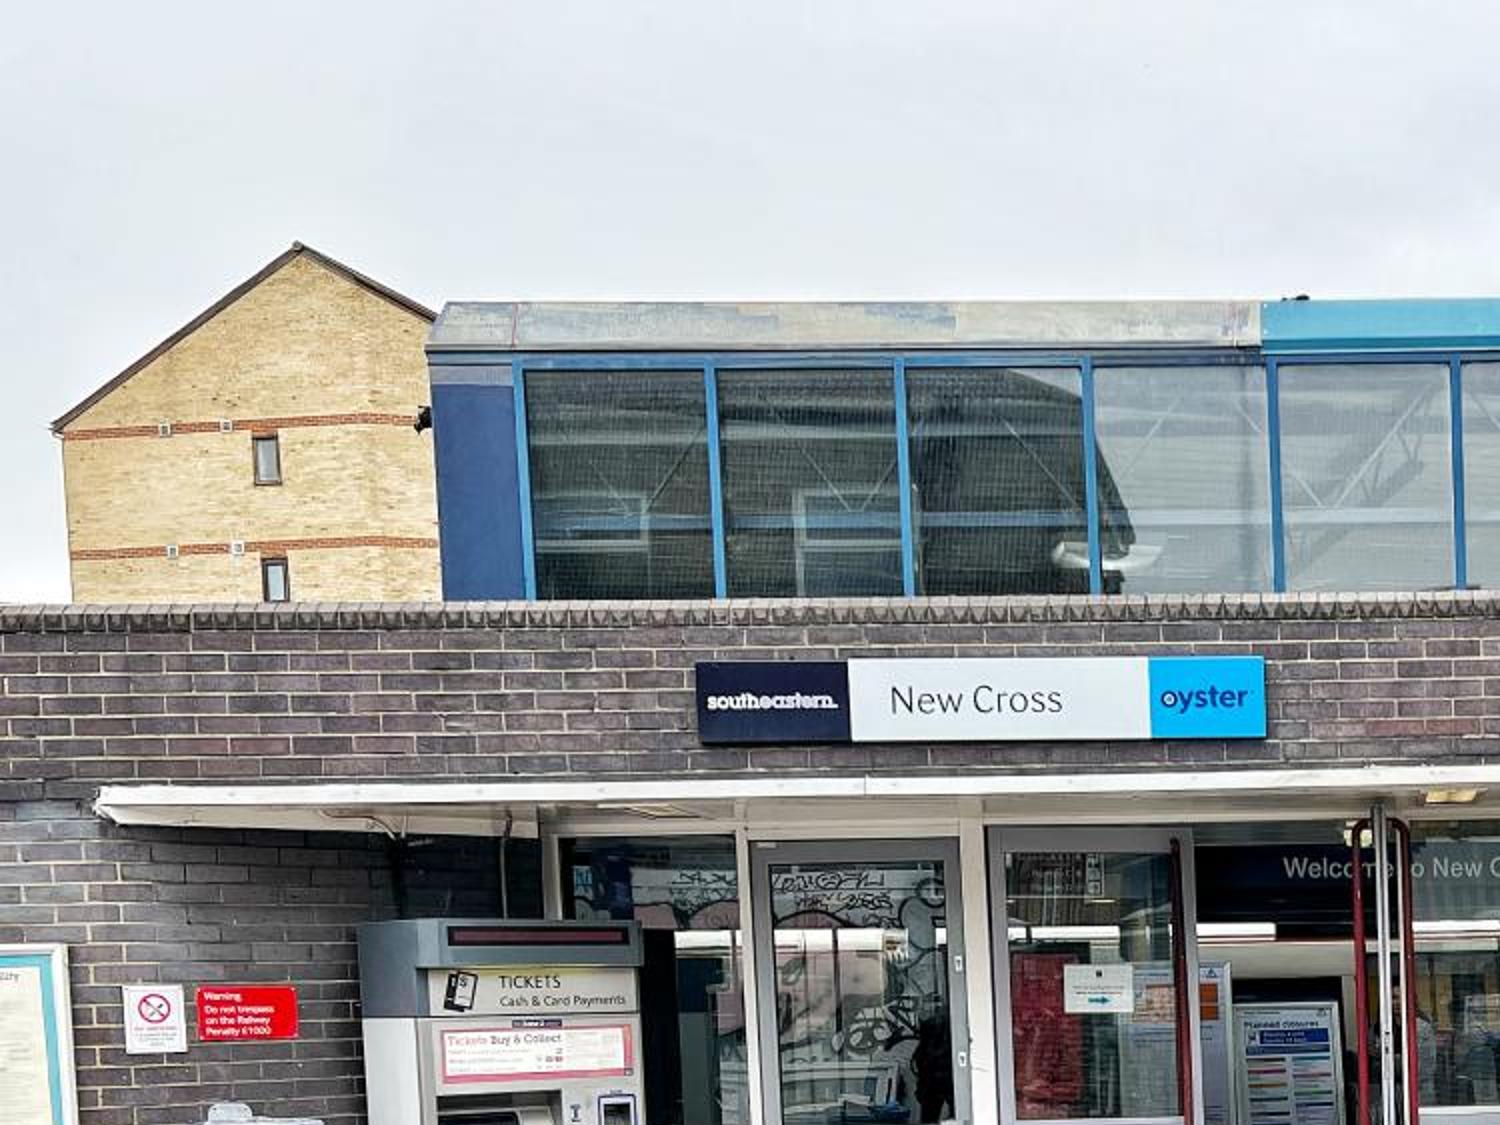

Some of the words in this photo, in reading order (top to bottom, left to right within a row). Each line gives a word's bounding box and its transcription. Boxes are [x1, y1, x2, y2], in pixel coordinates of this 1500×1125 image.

[891, 685, 963, 714] New
[973, 684, 1063, 713] Cross
[1160, 684, 1249, 714] oyster
[1432, 858, 1482, 878] New
[499, 974, 562, 989] TICKETS
[500, 995, 529, 1007] Cash
[532, 996, 541, 1006] &
[544, 996, 571, 1007] Card
[574, 994, 626, 1008] Payments
[204, 1004, 219, 1013] Do
[221, 1004, 237, 1013] not
[238, 1004, 275, 1015] trespass
[220, 1015, 236, 1025] the
[238, 1015, 271, 1027] Railway
[206, 1027, 239, 1038] Penalty
[491, 1034, 511, 1047] Buy
[523, 1032, 562, 1044] Collect
